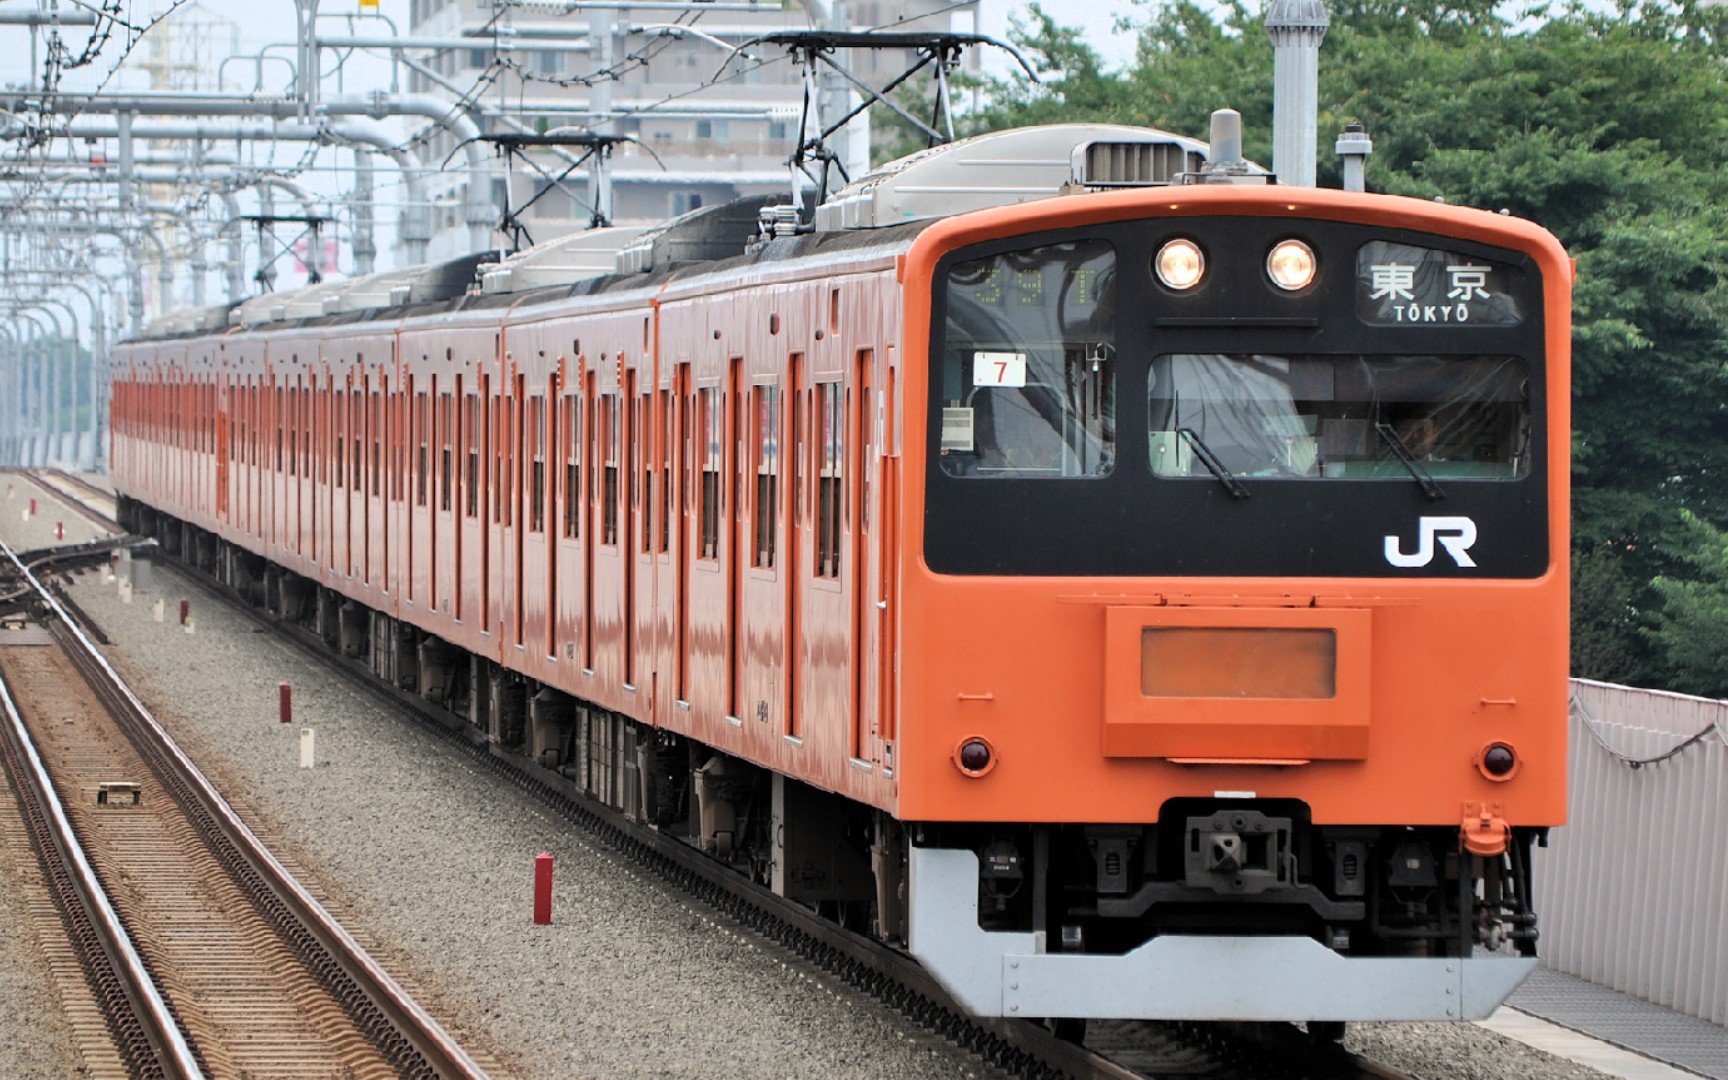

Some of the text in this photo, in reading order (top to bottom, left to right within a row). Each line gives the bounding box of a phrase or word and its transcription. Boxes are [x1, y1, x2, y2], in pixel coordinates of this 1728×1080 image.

[1370, 262, 1492, 300] 東京
[993, 361, 1008, 383] 7
[1384, 516, 1478, 567] JR
